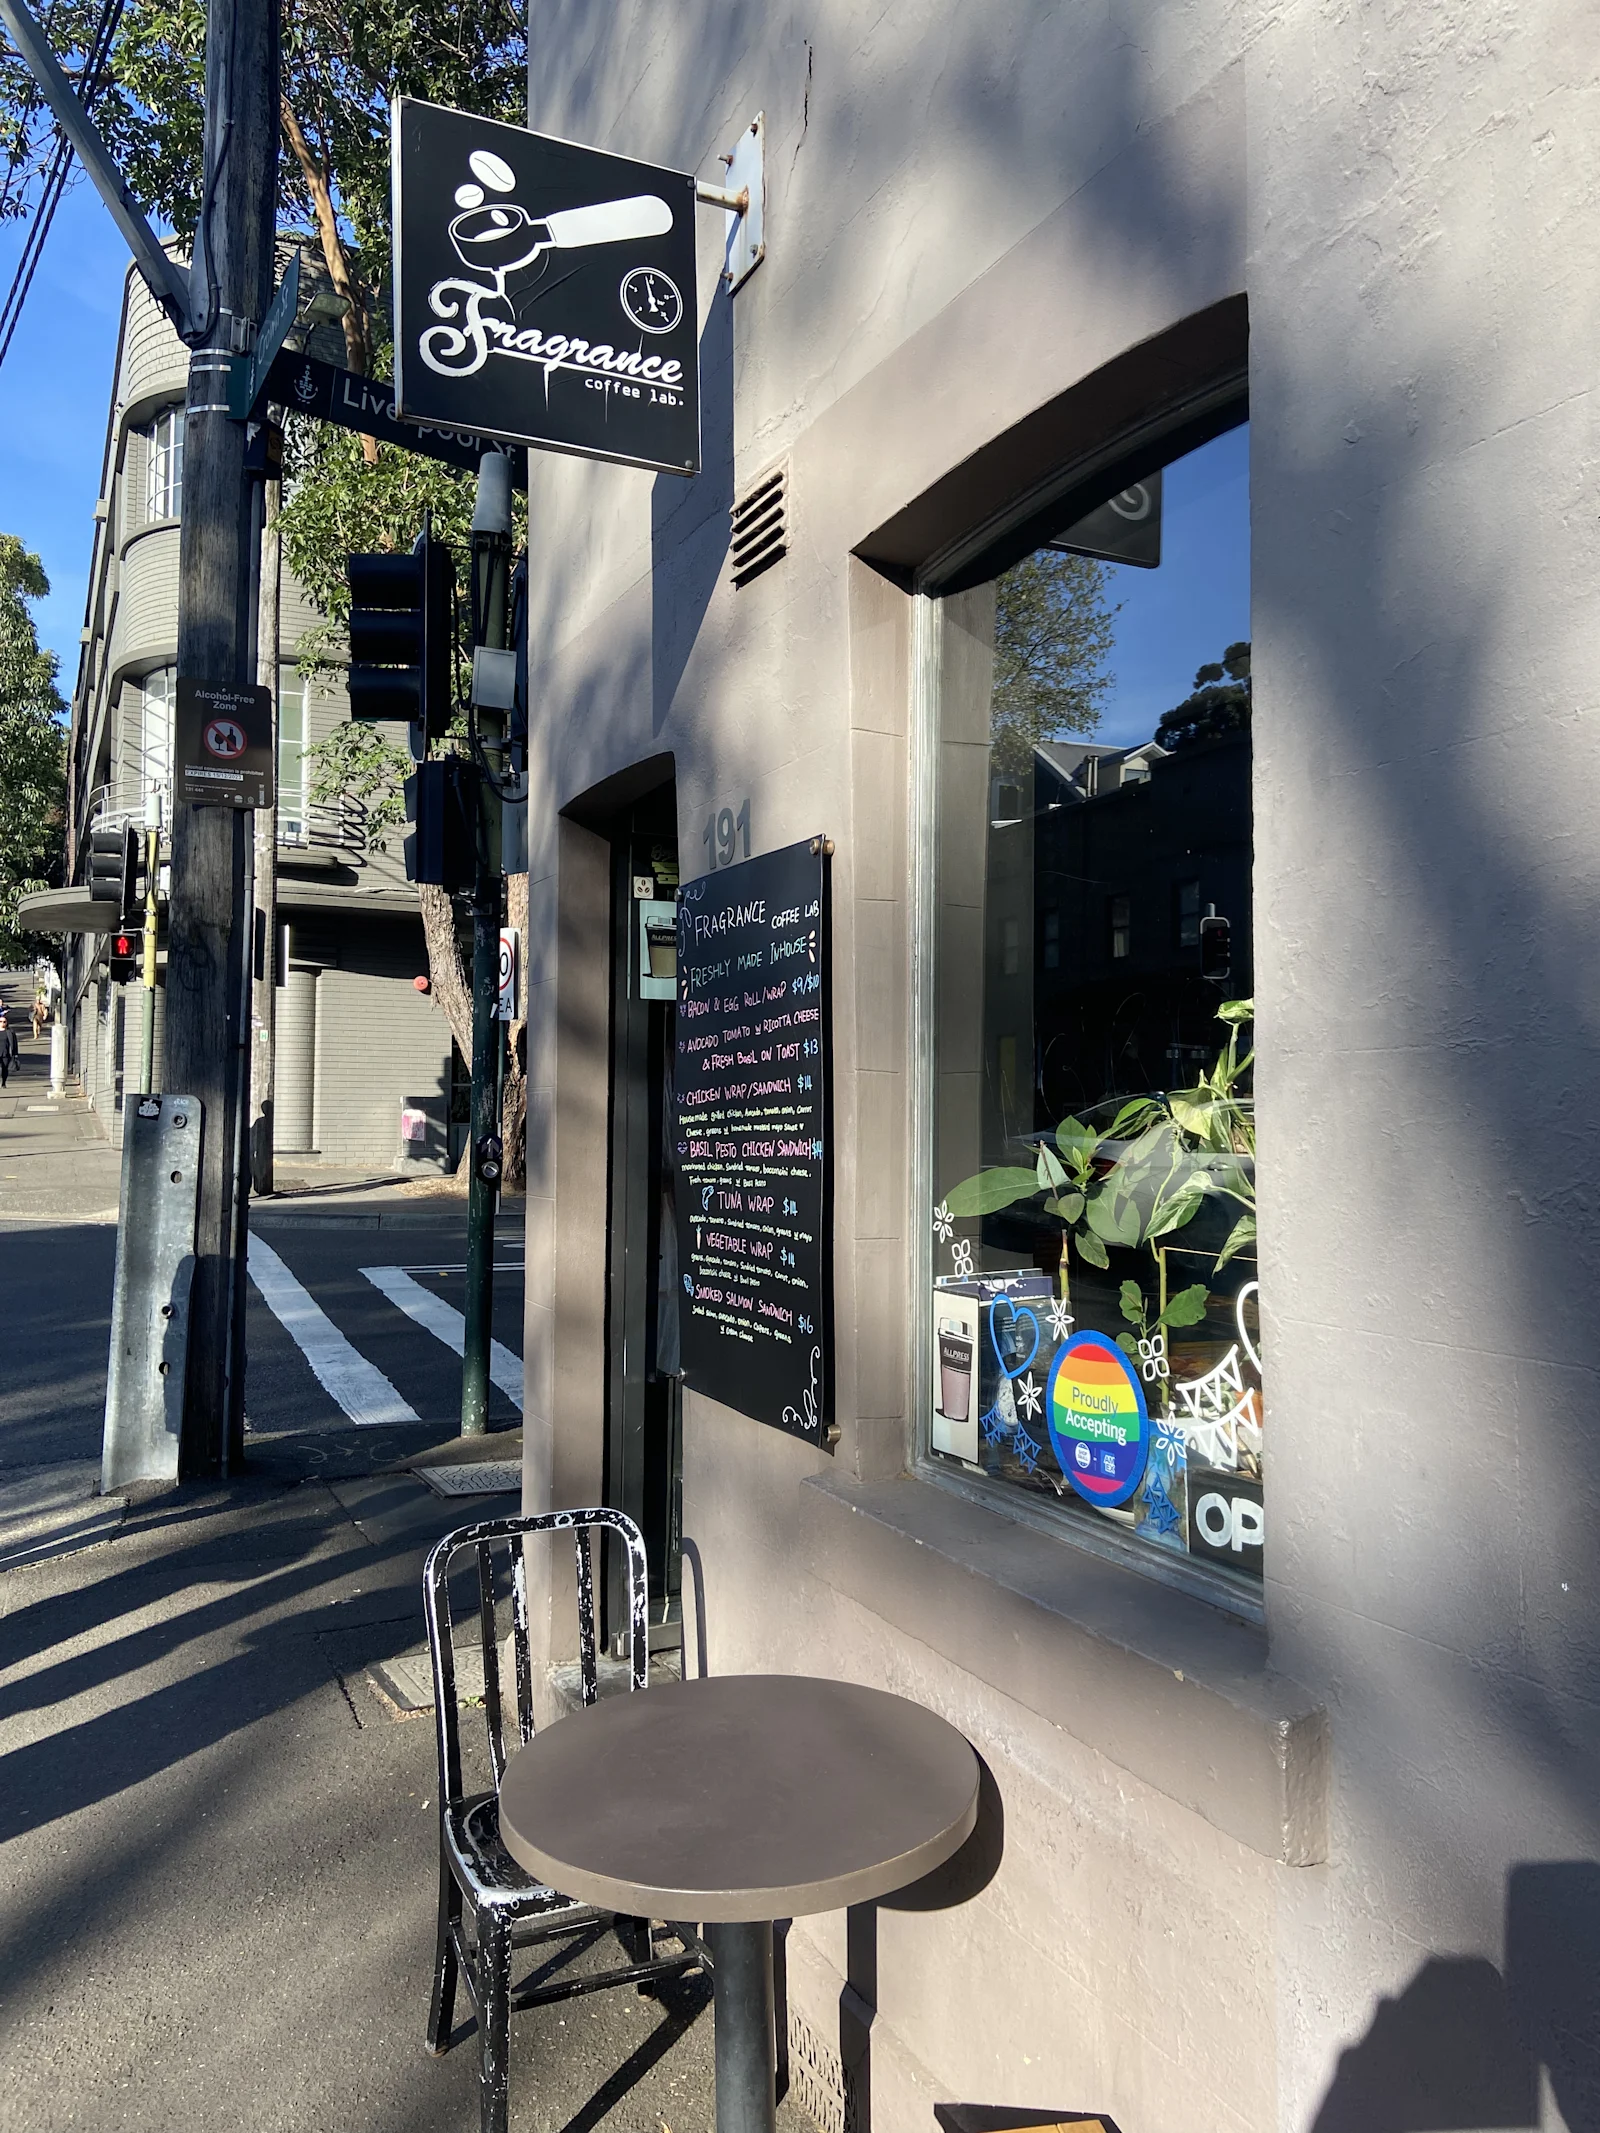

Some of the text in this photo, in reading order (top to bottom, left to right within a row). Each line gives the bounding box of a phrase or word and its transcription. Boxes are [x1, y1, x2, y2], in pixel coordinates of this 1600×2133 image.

[419, 277, 684, 377] Fragrance
[585, 378, 685, 406] coffee lab.
[343, 378, 482, 452] Livepoo
[194, 689, 255, 705] Alcohol-Free
[212, 700, 237, 712] Zone
[703, 798, 751, 871] 191
[651, 933, 677, 943] ALLPRES
[695, 899, 820, 947] FRAGRANCE COFFEE LAB
[690, 958, 731, 994] FRESHLY
[737, 951, 763, 971] MADE
[687, 998, 710, 1019] BACON
[714, 996, 720, 1012] &
[723, 996, 739, 1013] EGG
[687, 1034, 719, 1054] AVOCADO
[722, 1026, 751, 1044] TOMATO
[763, 1013, 792, 1033] RICOTTA
[793, 1007, 820, 1025] CHEESE
[702, 1057, 710, 1071] &
[711, 1053, 734, 1072] FRESH
[761, 1046, 772, 1062] ON
[776, 1043, 800, 1061] TOAST
[803, 1038, 819, 1059] $13
[686, 1086, 721, 1106] CHICKEN
[797, 1073, 813, 1094] $14
[690, 1140, 714, 1158] BASIL
[715, 1141, 737, 1160] PESTO
[742, 1139, 775, 1158] CHICKEN
[777, 1138, 812, 1161] SANDWICH
[717, 1190, 799, 1217] TUNA WRAP $14
[706, 1231, 796, 1269] VEGETABLE WRAP $14
[695, 1283, 814, 1335] SMOKED SALMON SANDWICH $16
[943, 1346, 970, 1361] ALLPRESS
[1072, 1386, 1119, 1419] Proudly
[1065, 1408, 1127, 1446] Accepting
[1196, 1492, 1264, 1552] OP
